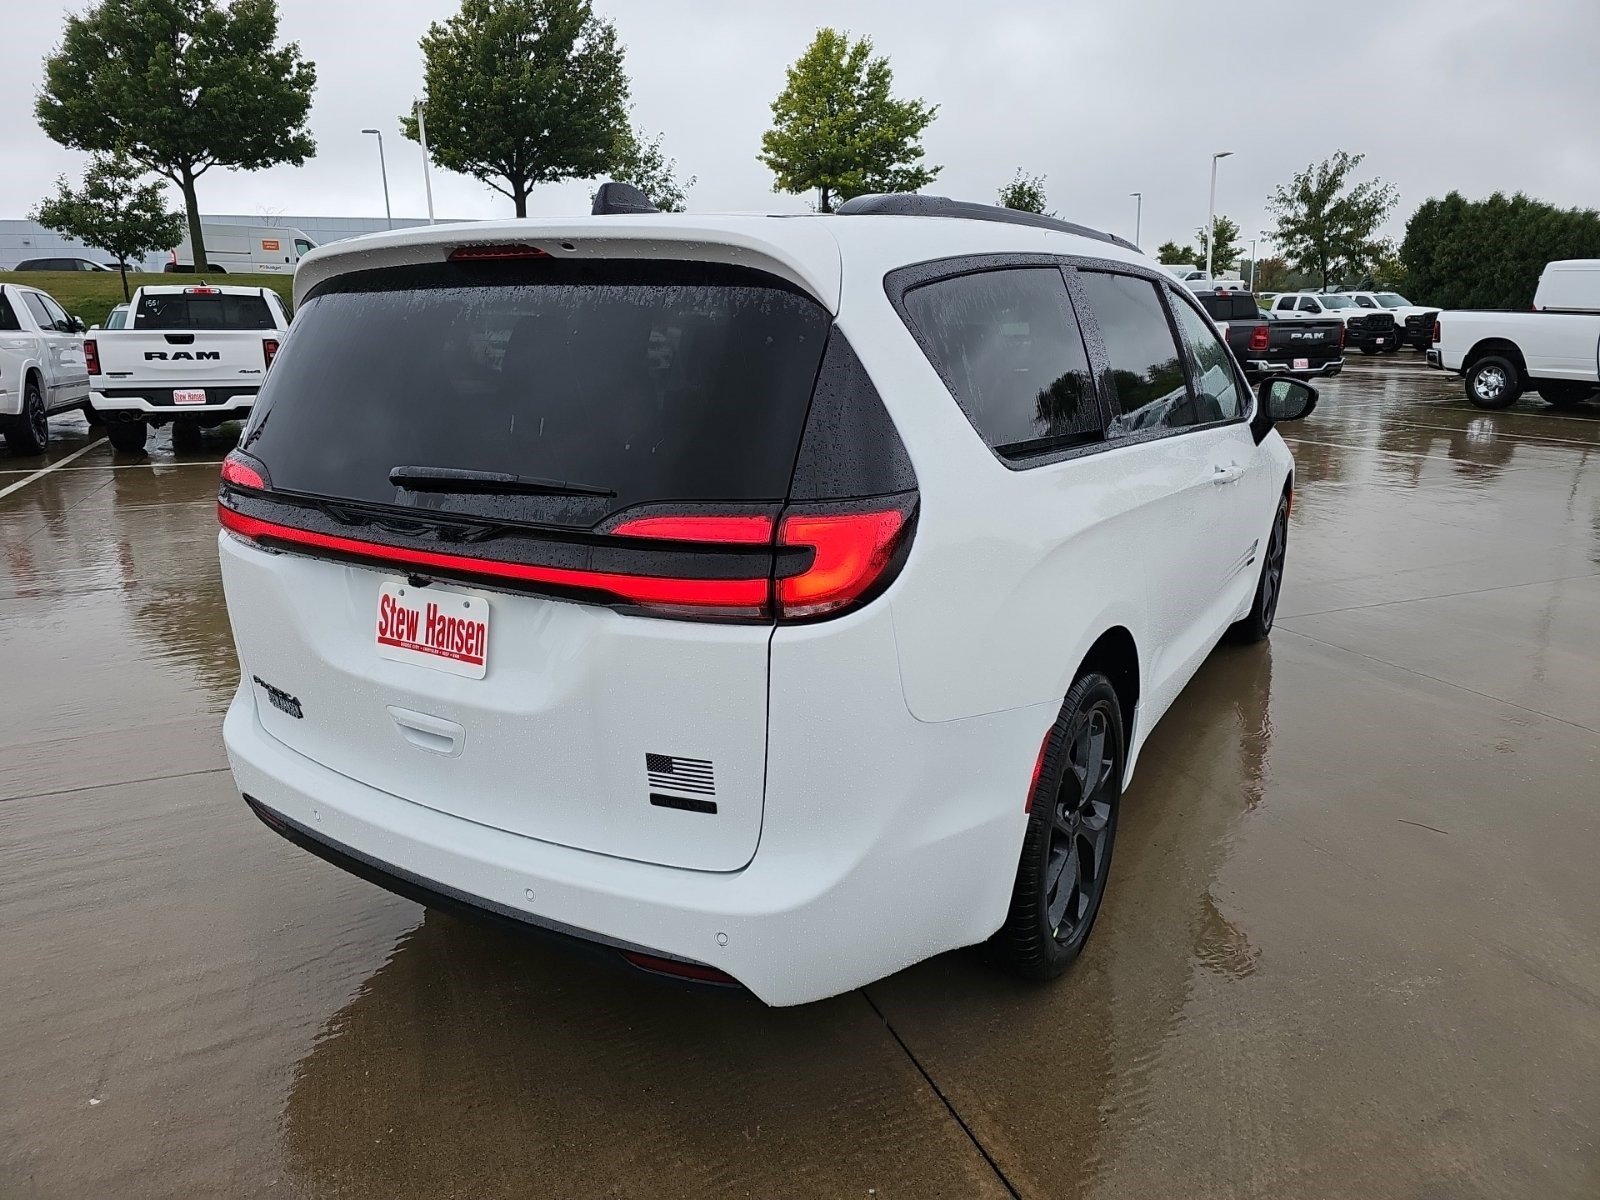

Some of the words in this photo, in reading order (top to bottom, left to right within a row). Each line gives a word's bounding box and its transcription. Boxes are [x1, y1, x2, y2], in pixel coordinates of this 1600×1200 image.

[144, 351, 220, 360] RAM
[174, 392, 187, 400] Stew
[187, 392, 204, 400] Hansen
[378, 593, 420, 642] Stew
[424, 602, 485, 657] Hansen
